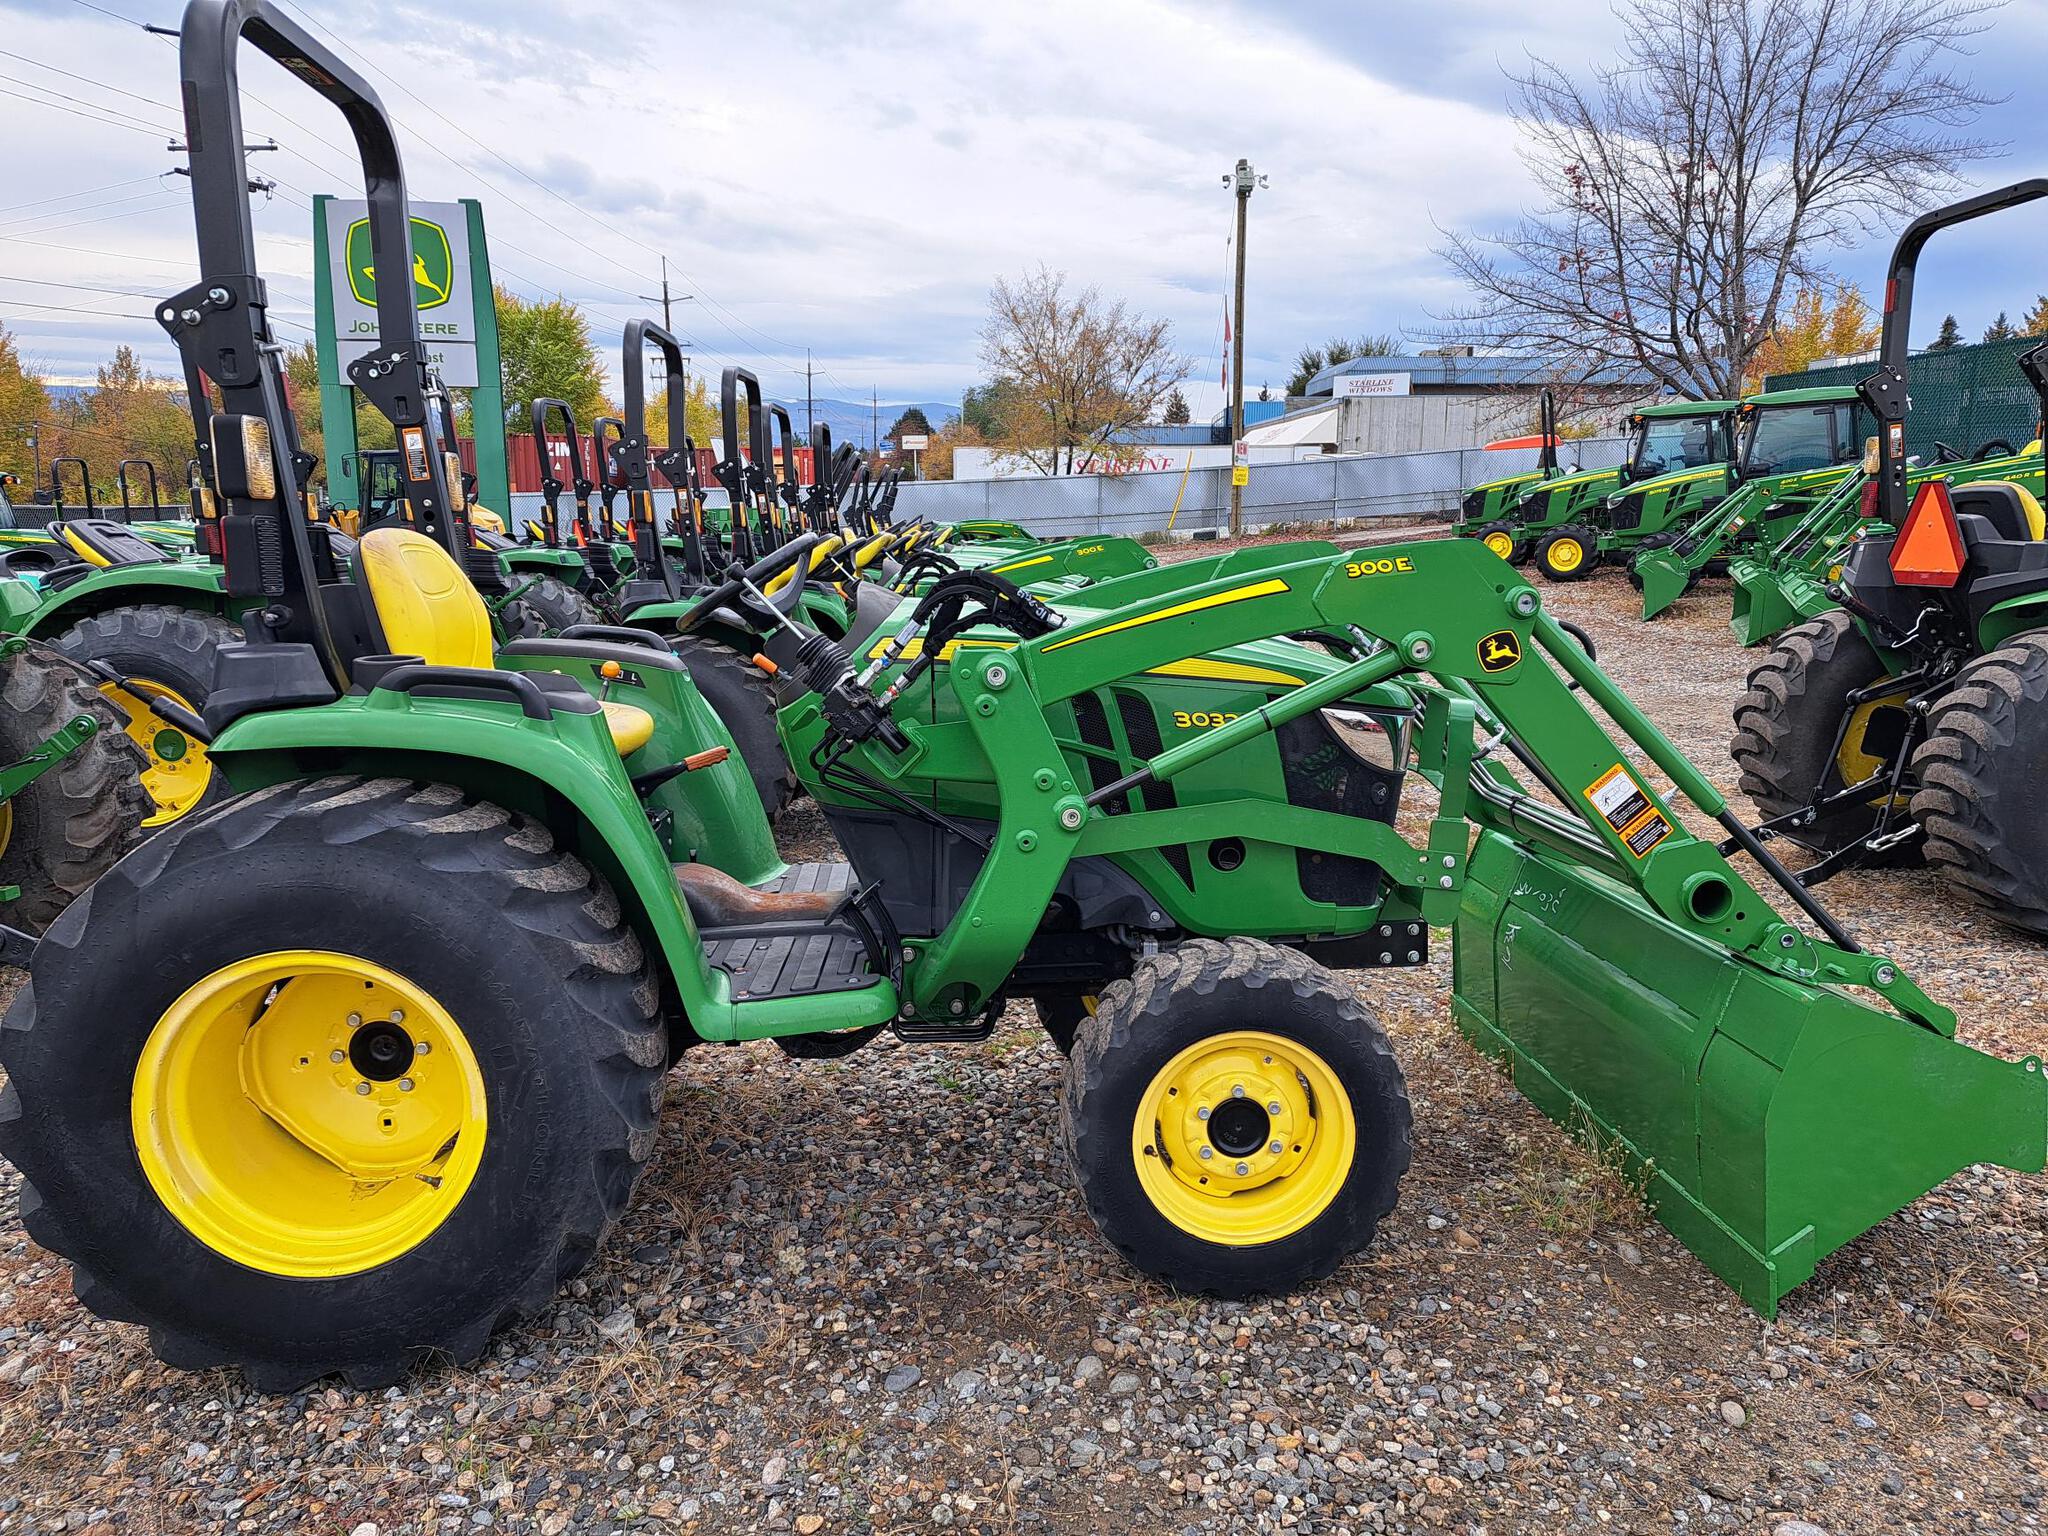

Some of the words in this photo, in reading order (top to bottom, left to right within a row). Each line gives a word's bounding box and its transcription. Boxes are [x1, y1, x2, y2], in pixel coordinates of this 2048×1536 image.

[349, 320, 381, 333] JOH
[418, 323, 458, 335] EERE
[1349, 378, 1395, 387] STARLINE
[1349, 386, 1393, 394] WINDOWS
[1595, 767, 1620, 789] WARNING
